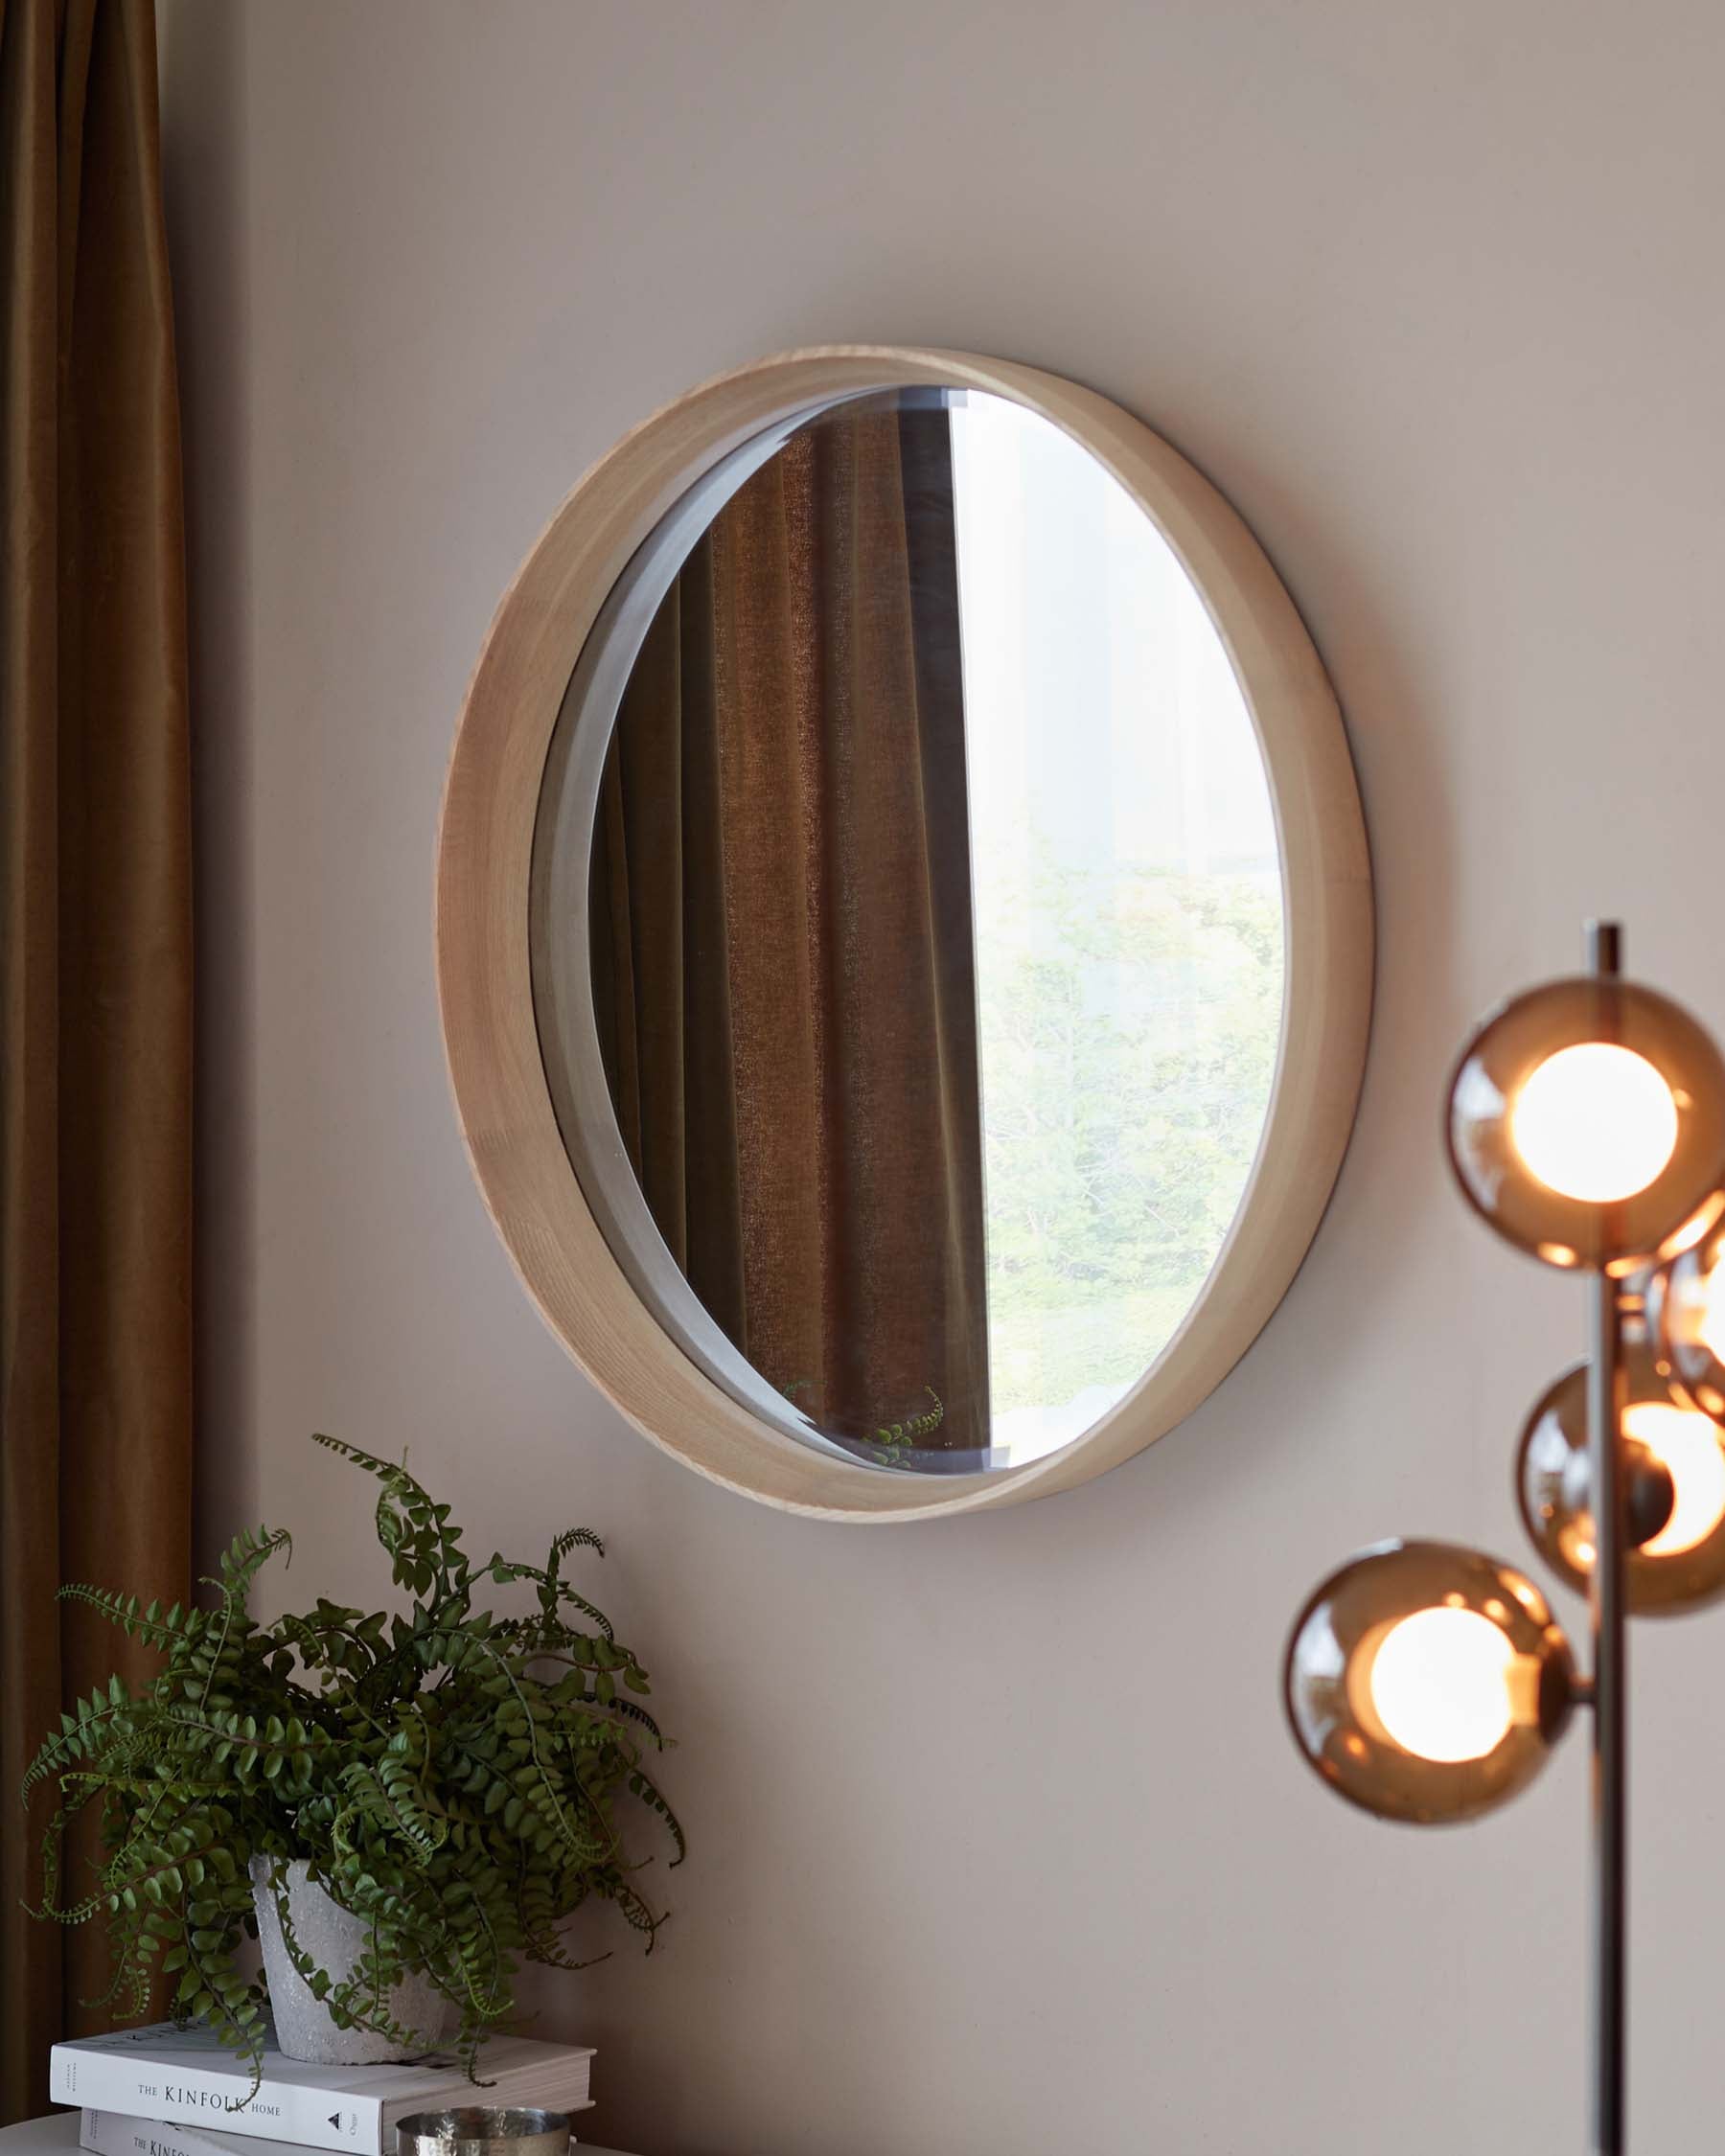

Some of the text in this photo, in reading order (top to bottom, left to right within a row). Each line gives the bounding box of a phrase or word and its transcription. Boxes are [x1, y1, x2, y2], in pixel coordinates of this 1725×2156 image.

[138, 2084, 281, 2117] THE KINFOLK HOME
[133, 2137, 146, 2150] THE
